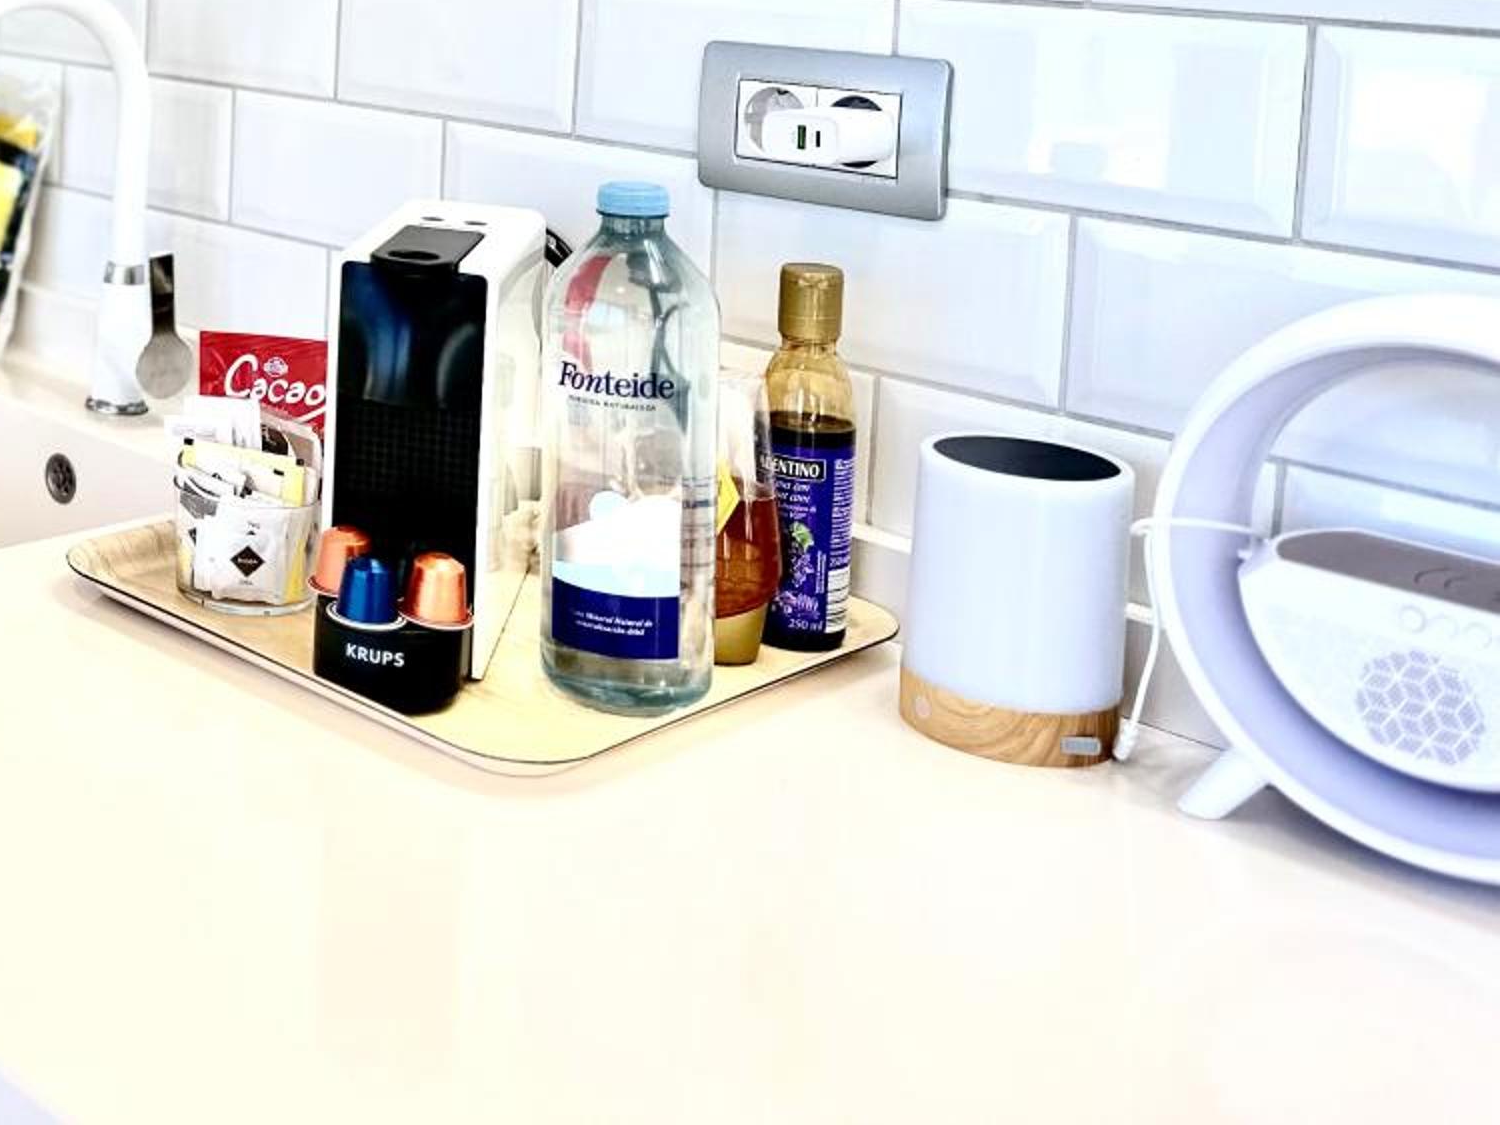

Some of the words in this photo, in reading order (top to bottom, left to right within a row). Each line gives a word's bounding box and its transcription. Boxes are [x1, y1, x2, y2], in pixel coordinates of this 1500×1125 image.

[224, 353, 326, 407] Cacao
[558, 360, 676, 400] Fonteide
[787, 618, 809, 631] 250
[345, 642, 405, 668] KRUPS
